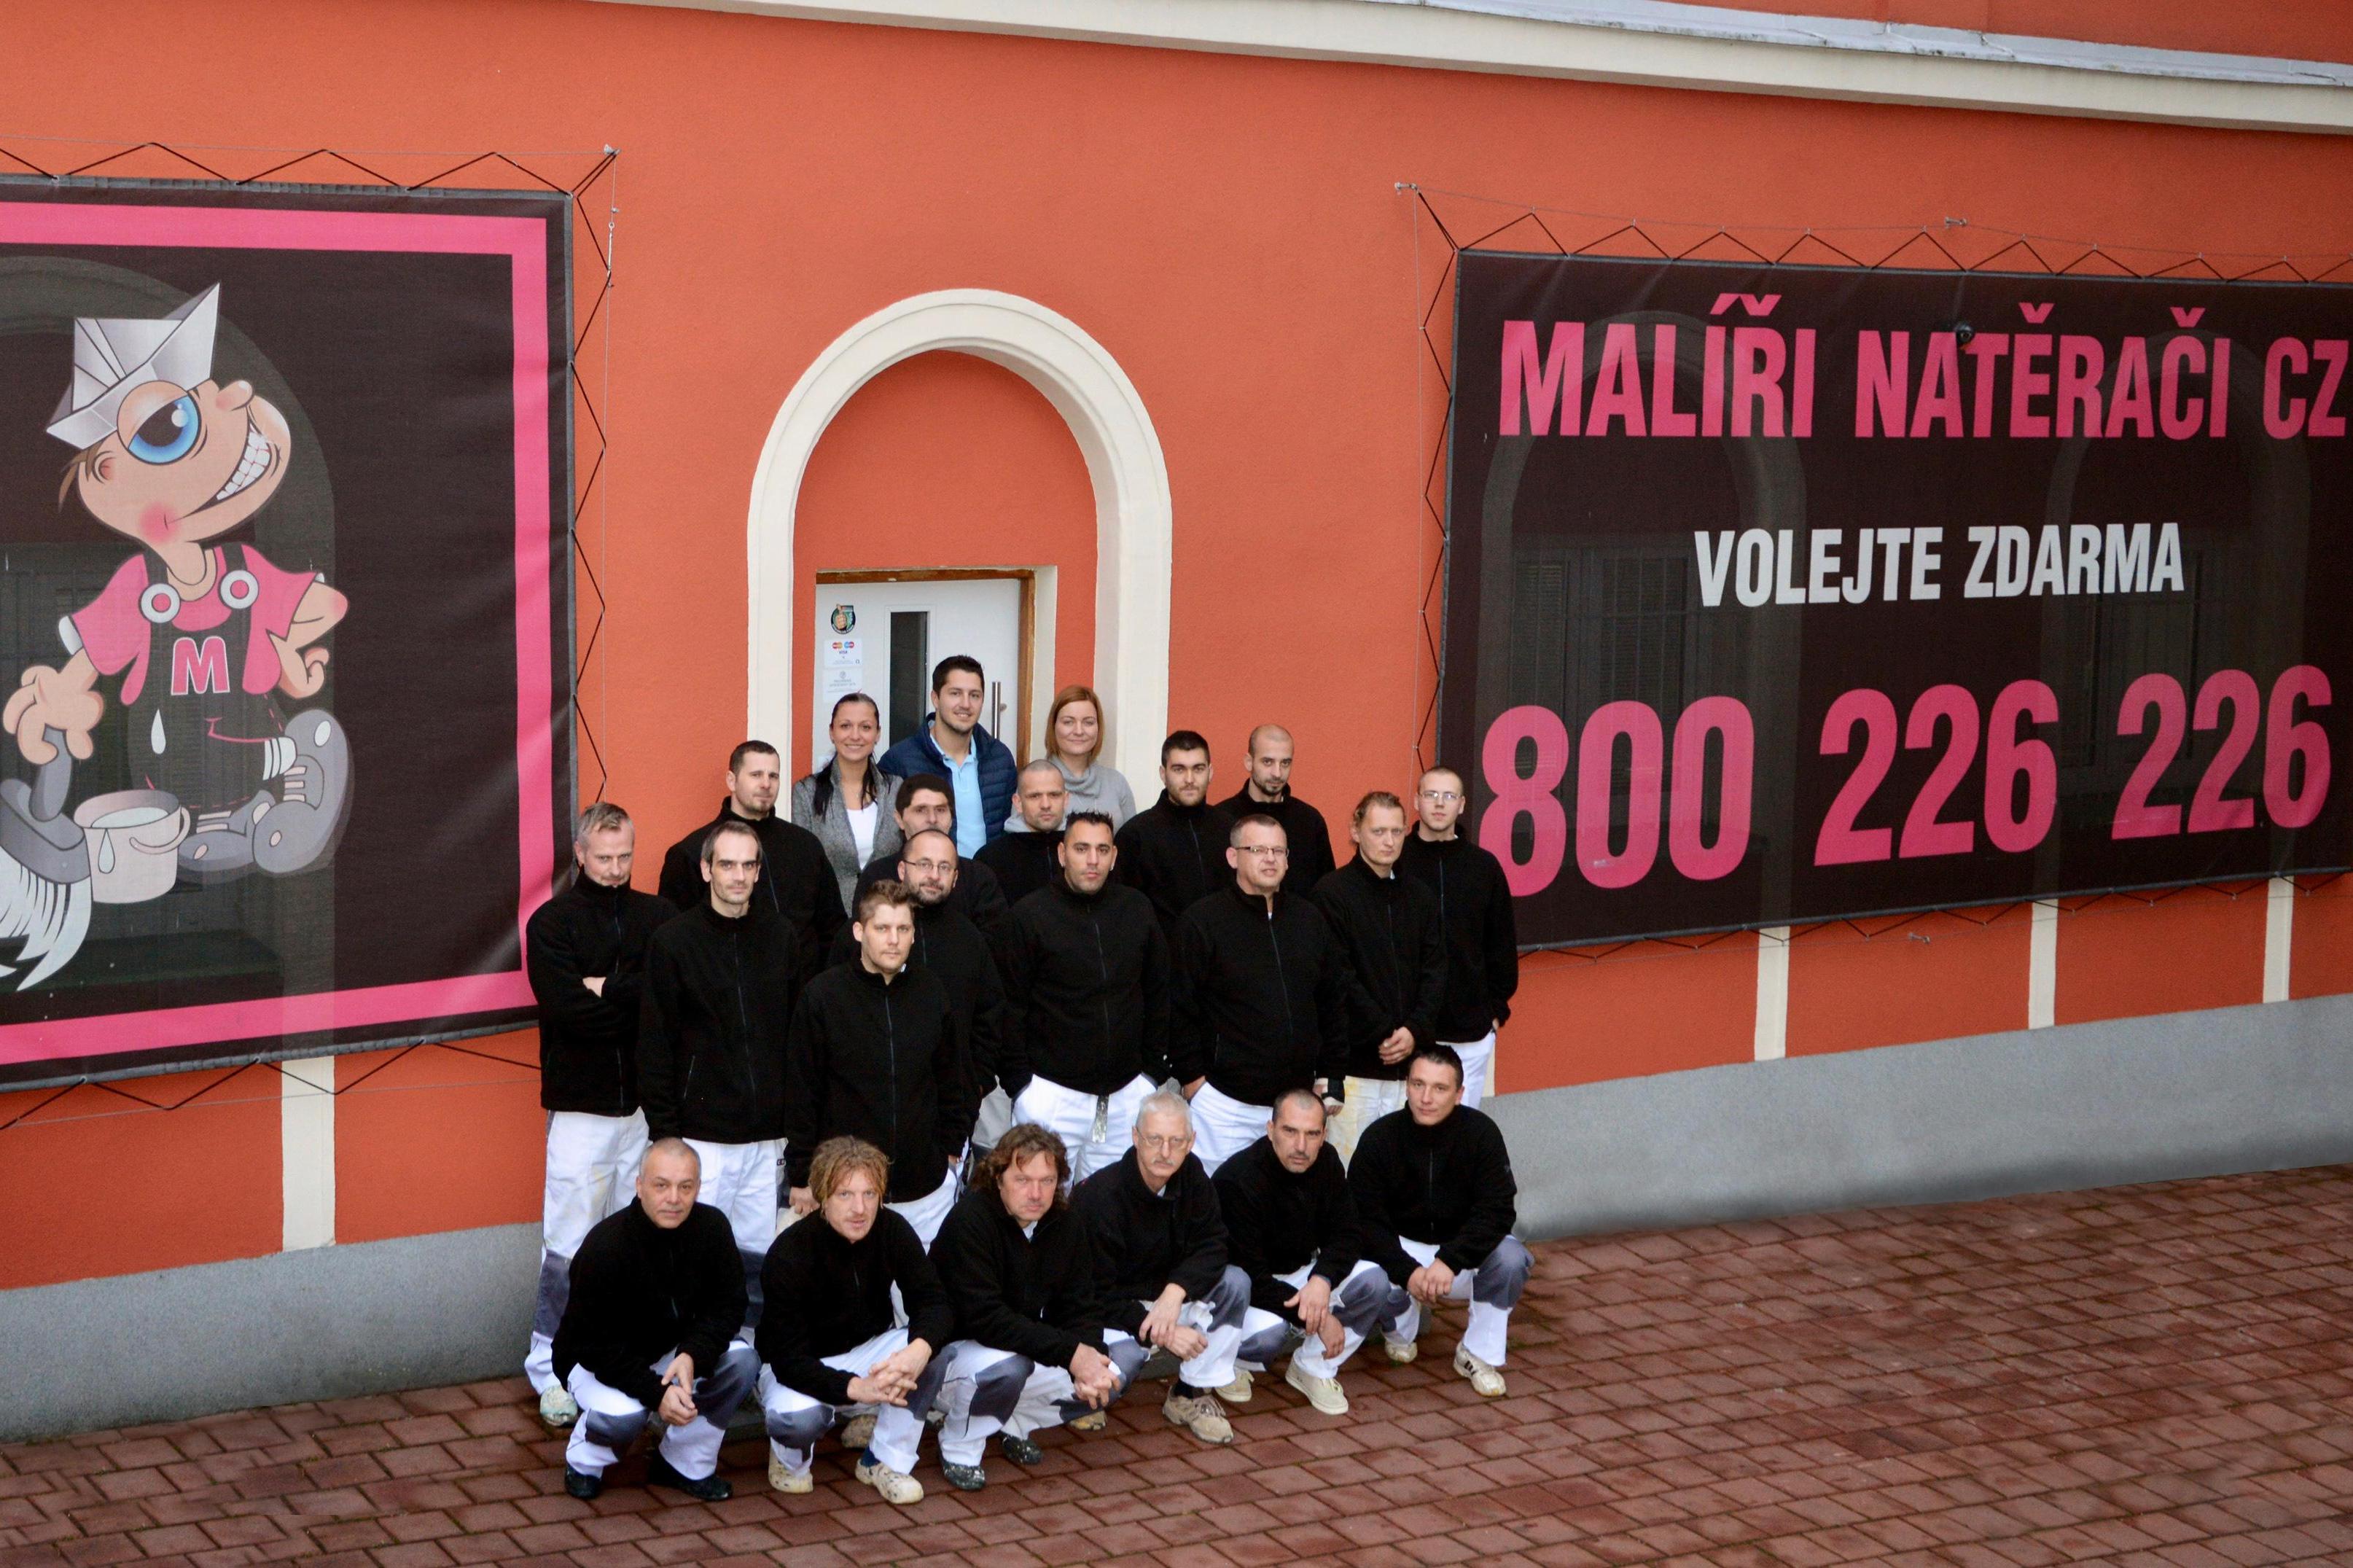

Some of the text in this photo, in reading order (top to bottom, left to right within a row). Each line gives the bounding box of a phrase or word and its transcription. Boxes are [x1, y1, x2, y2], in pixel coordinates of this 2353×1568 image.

[1499, 292, 2349, 440] MALÍŘI NATĚRAČI CZ
[1694, 523, 2185, 608] VOLEJTE ZDARMA
[171, 636, 230, 696] M
[1478, 665, 2332, 897] 800 226 226
